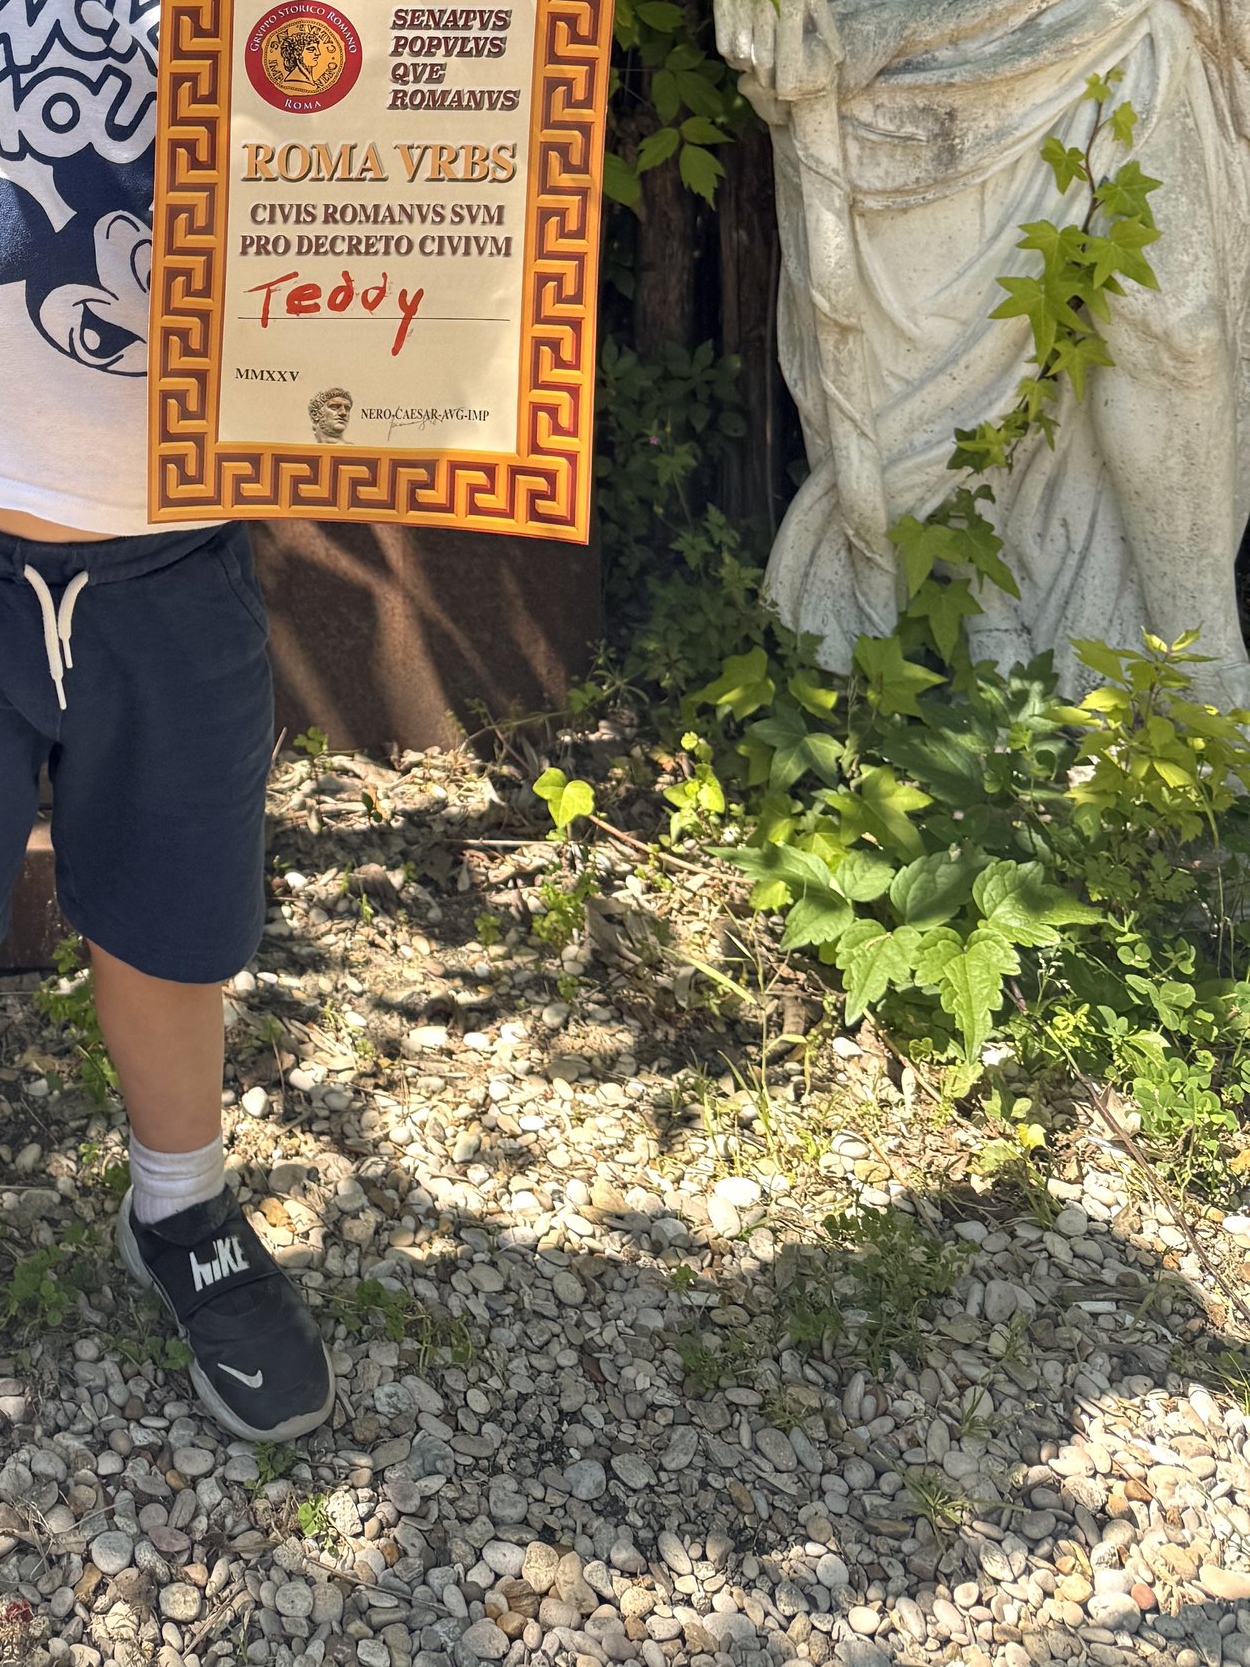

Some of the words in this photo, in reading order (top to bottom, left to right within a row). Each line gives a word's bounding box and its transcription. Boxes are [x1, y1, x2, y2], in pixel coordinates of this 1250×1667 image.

[278, 4, 326, 18] STORICO
[327, 11, 358, 54] ROMANO
[390, 8, 513, 31] SENATVS
[389, 35, 507, 58] POPVLVS
[389, 62, 448, 86] QVE
[284, 98, 322, 110] ROMA
[386, 89, 521, 111] ROMANVS
[241, 141, 389, 182] ROMA
[393, 142, 517, 183] VRBS
[249, 203, 317, 225] CIVIS
[321, 203, 446, 226] ROMANVS
[449, 203, 506, 226] SVM
[239, 234, 291, 257] PRO
[296, 234, 414, 257] DECRETO
[418, 234, 513, 258] CIVIVM
[244, 270, 425, 357] Teddy
[235, 367, 300, 384] MMXXV
